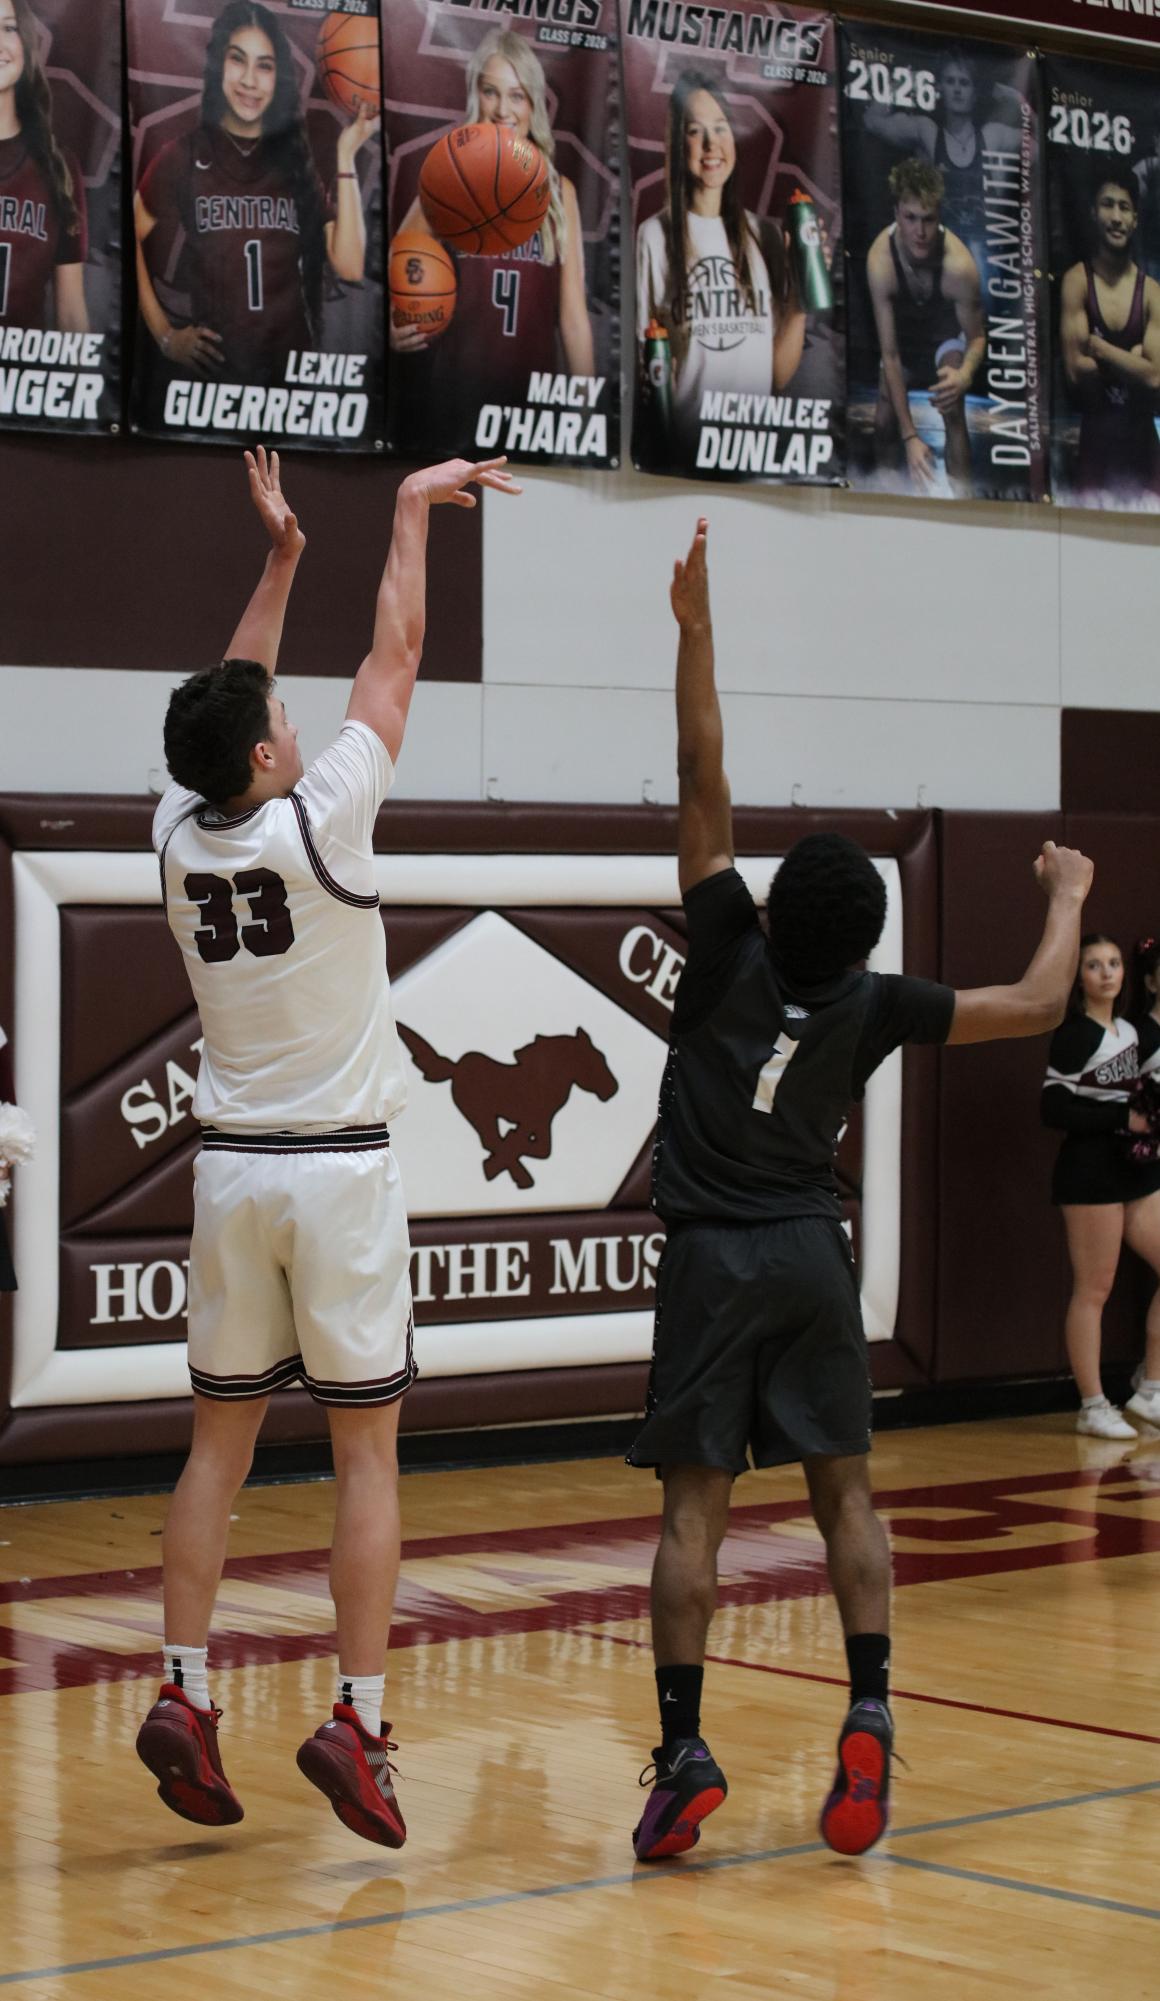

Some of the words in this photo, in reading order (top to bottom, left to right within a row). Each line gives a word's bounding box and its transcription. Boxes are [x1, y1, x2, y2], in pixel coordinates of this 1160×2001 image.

[539, 27, 569, 44] CLASS
[570, 31, 585, 46] OF
[585, 33, 607, 49] 2026
[626, 0, 827, 65] MUSTANGS
[850, 42, 896, 63] Senior
[763, 64, 793, 80] CLASS
[794, 68, 807, 81] OF
[847, 59, 937, 111] 2026
[1051, 86, 1093, 107] Senior
[1020, 103, 1032, 193] WRESTLING
[1050, 105, 1132, 154] 2026
[982, 150, 1023, 299] GAWITH
[1021, 201, 1034, 266] SCHOOL
[244, 239, 264, 311] 1
[492, 268, 520, 336] 4
[1023, 272, 1036, 313] HIGH
[0, 326, 105, 367] ROOKE
[285, 350, 368, 387] LEXIE
[1025, 319, 1038, 389] CENTRAL
[164, 379, 369, 437] GUERRERO
[527, 371, 606, 408] MACY
[700, 390, 832, 430] MCKYNLEE
[987, 316, 1031, 466] DAYGEN
[475, 404, 607, 457] O'HARA
[1028, 395, 1041, 450] SALINA
[696, 426, 833, 475] DUNLAP
[183, 866, 296, 964] 33
[121, 1036, 204, 1149] SA
[89, 1258, 190, 1325] HO
[409, 1241, 531, 1302] THE
